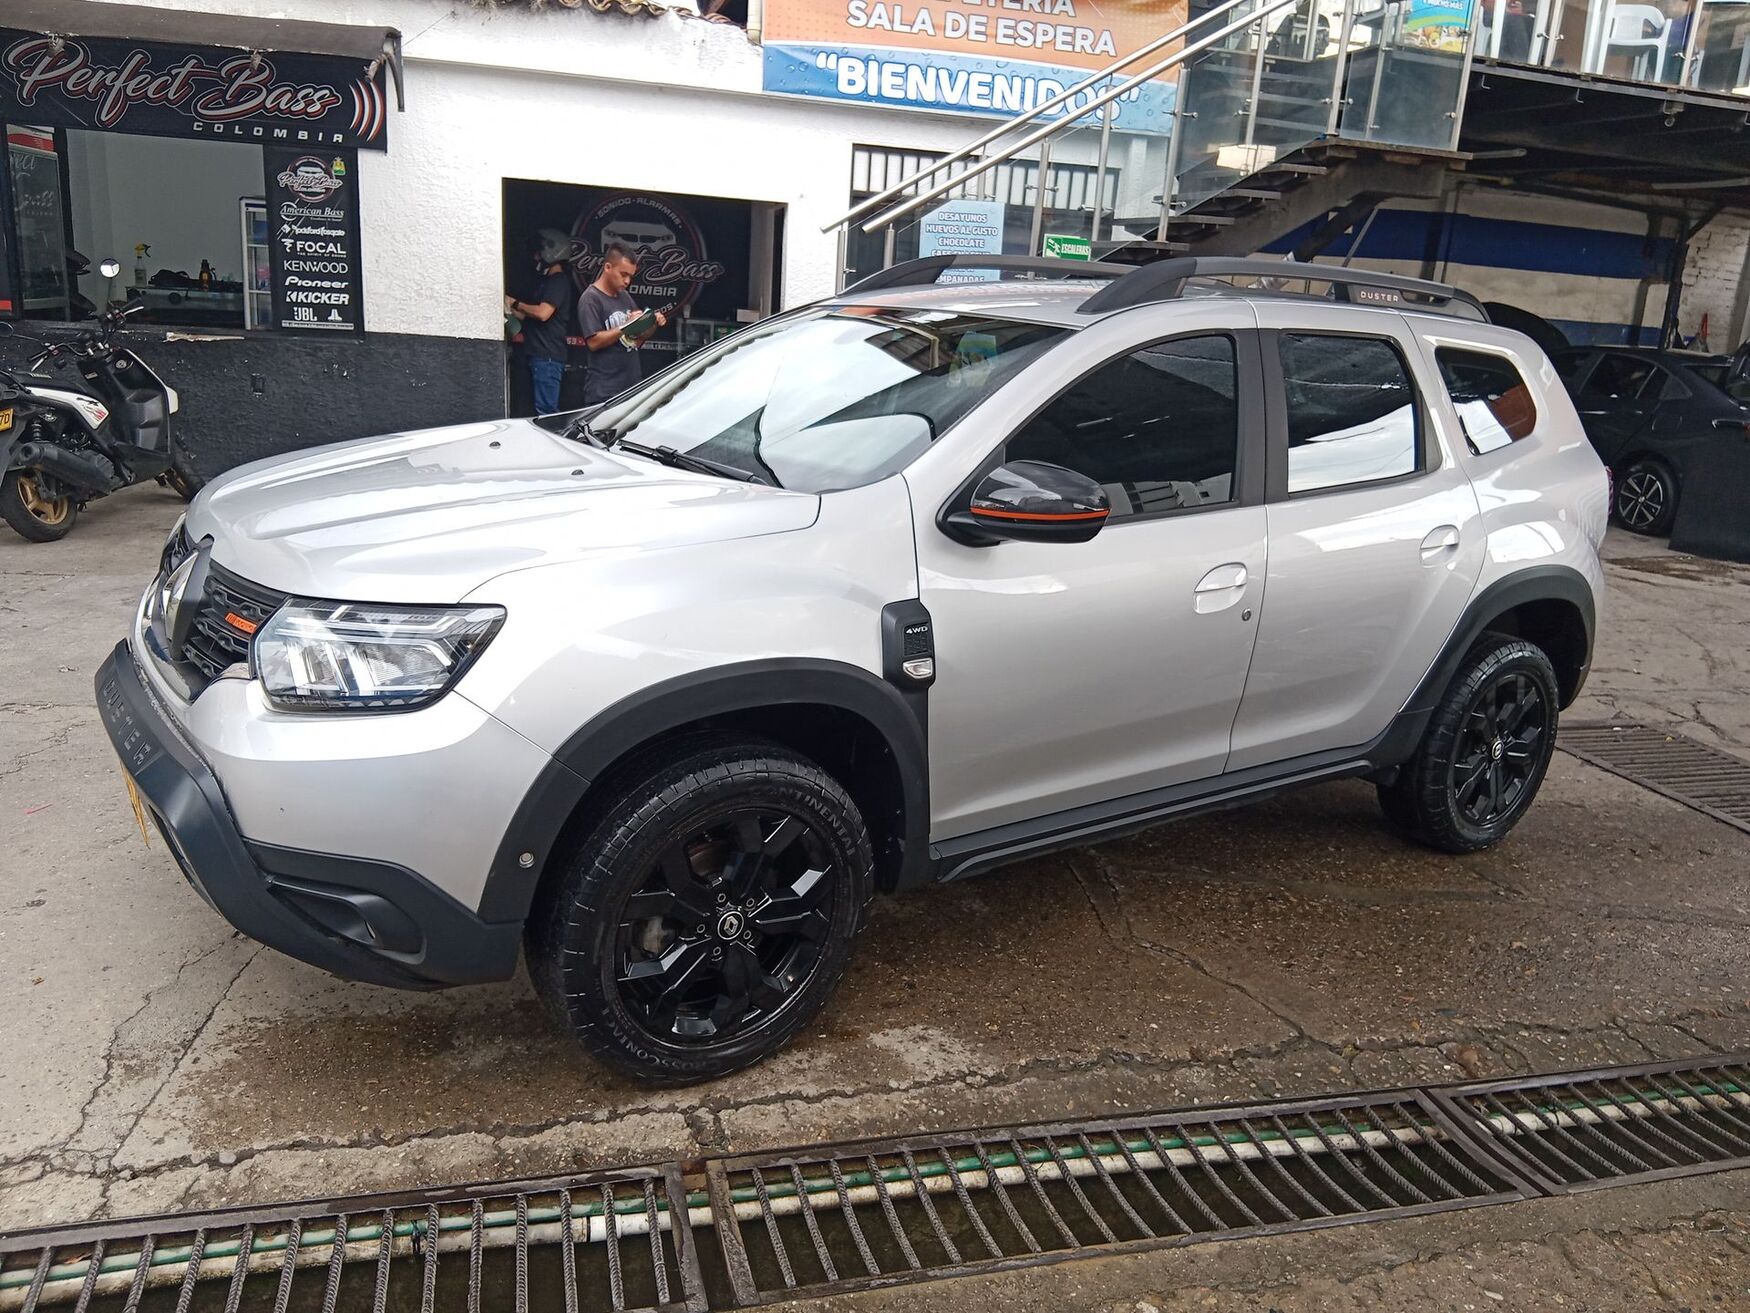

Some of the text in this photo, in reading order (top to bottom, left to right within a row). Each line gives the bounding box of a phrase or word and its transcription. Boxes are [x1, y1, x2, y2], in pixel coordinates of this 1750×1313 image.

[847, 1, 1118, 57] SALA DE ESPERA
[5, 38, 340, 126] Perfect Bass
[193, 122, 344, 143] COLOMBIA
[280, 205, 345, 217] American Bass
[598, 197, 682, 224] SONIDO ALARMAS
[938, 212, 988, 223] DESAYUNOS
[926, 224, 998, 236] HUEVOS AL GUSTO
[296, 241, 347, 254] FOCAL
[938, 237, 985, 248] CHOCOLATE
[283, 260, 349, 274] KENWOOD
[643, 247, 721, 283] Bass
[284, 275, 349, 289] Pioneer
[628, 285, 677, 297] OMBIA
[1360, 290, 1399, 302] DUSTER
[296, 292, 350, 305] KICKER
[294, 307, 318, 321] JBL
[906, 625, 928, 635] 4WD
